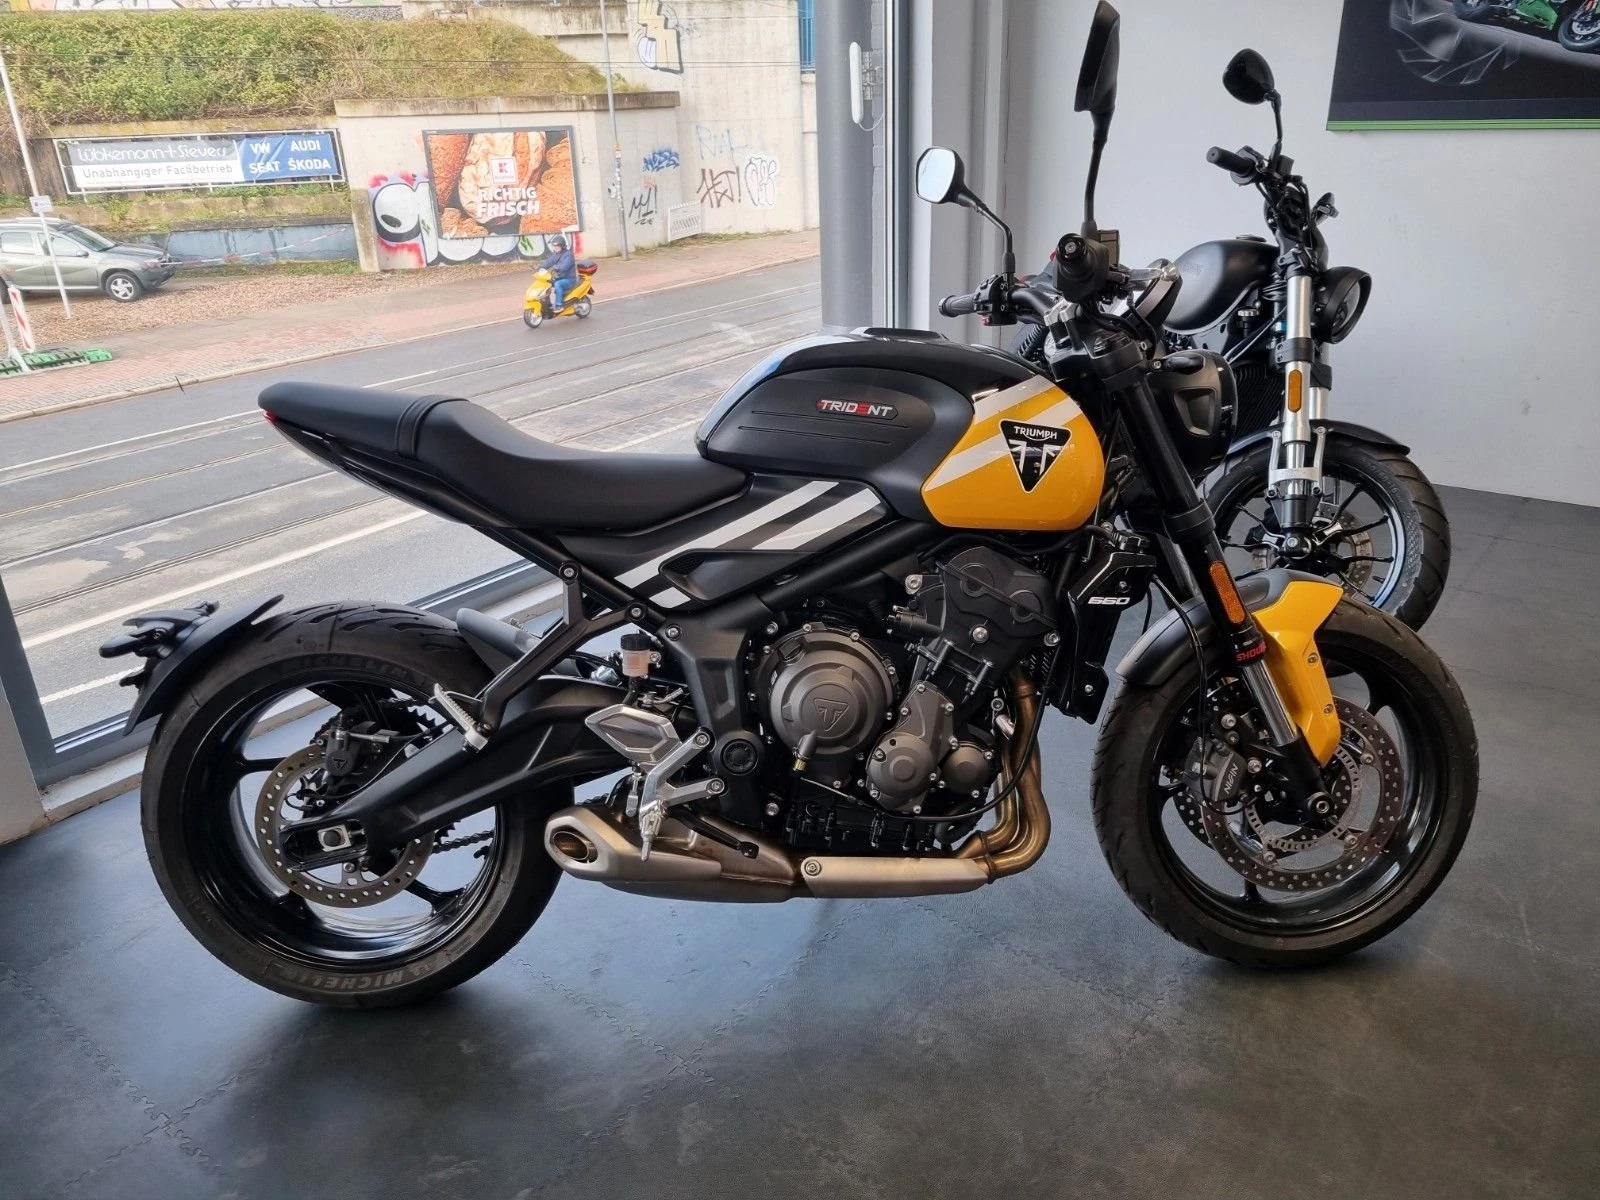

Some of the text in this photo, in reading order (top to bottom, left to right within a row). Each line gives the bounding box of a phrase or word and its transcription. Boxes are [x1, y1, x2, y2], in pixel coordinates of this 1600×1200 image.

[249, 139, 321, 155] VW AUDI
[166, 163, 233, 176] Fachbetrieb
[249, 157, 331, 174] SEAT ŠKODA
[478, 185, 538, 202] RICHTIG
[476, 200, 541, 218] FRISCH
[818, 399, 893, 418] TRIDENT
[1013, 424, 1058, 440] TRIUMPH
[1087, 596, 1131, 605] 660
